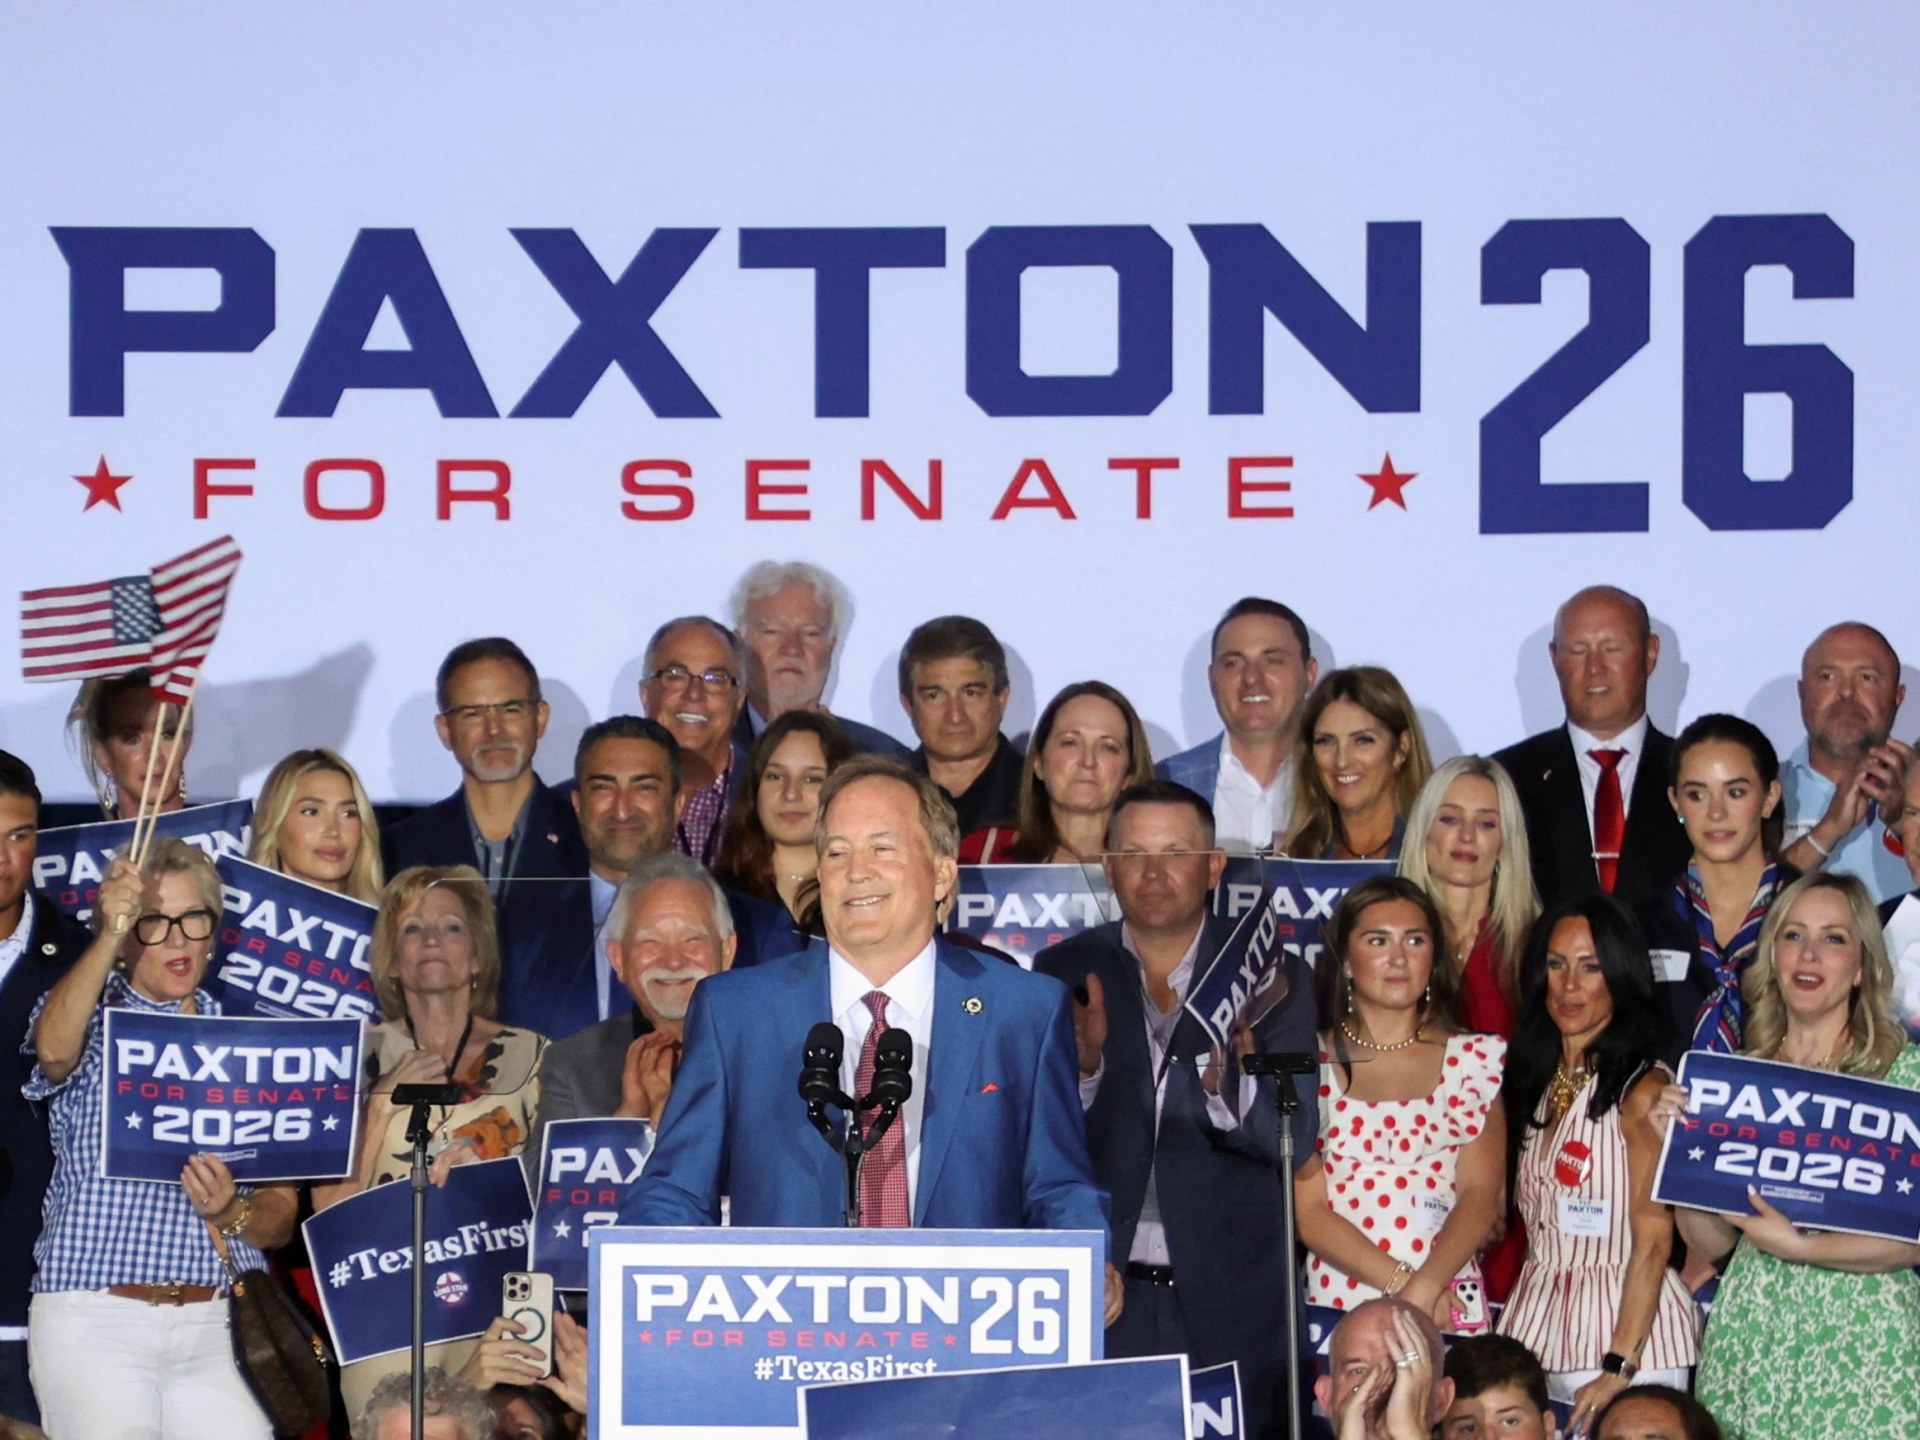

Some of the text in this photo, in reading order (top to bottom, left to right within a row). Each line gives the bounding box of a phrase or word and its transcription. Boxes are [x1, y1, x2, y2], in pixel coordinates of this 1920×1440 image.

[47, 213, 1855, 535] PAXTON 26
[193, 456, 1294, 521] FOR SENATE
[1210, 898, 1277, 1044] PAXTO
[115, 1038, 353, 1084] PAXTON
[118, 1081, 350, 1104] FOR SENATE
[1689, 1077, 1920, 1149] PAXTON
[153, 1105, 312, 1146] 2026
[1684, 1119, 1758, 1140] FOR
[1714, 1141, 1885, 1196] 2026
[547, 1188, 618, 1205] FOR
[1568, 1204, 1603, 1215] PAXTON
[632, 1273, 1061, 1355] PAXTON 26
[665, 1329, 930, 1348] FOR SENATE
[753, 1354, 938, 1382] #TexasFirst
